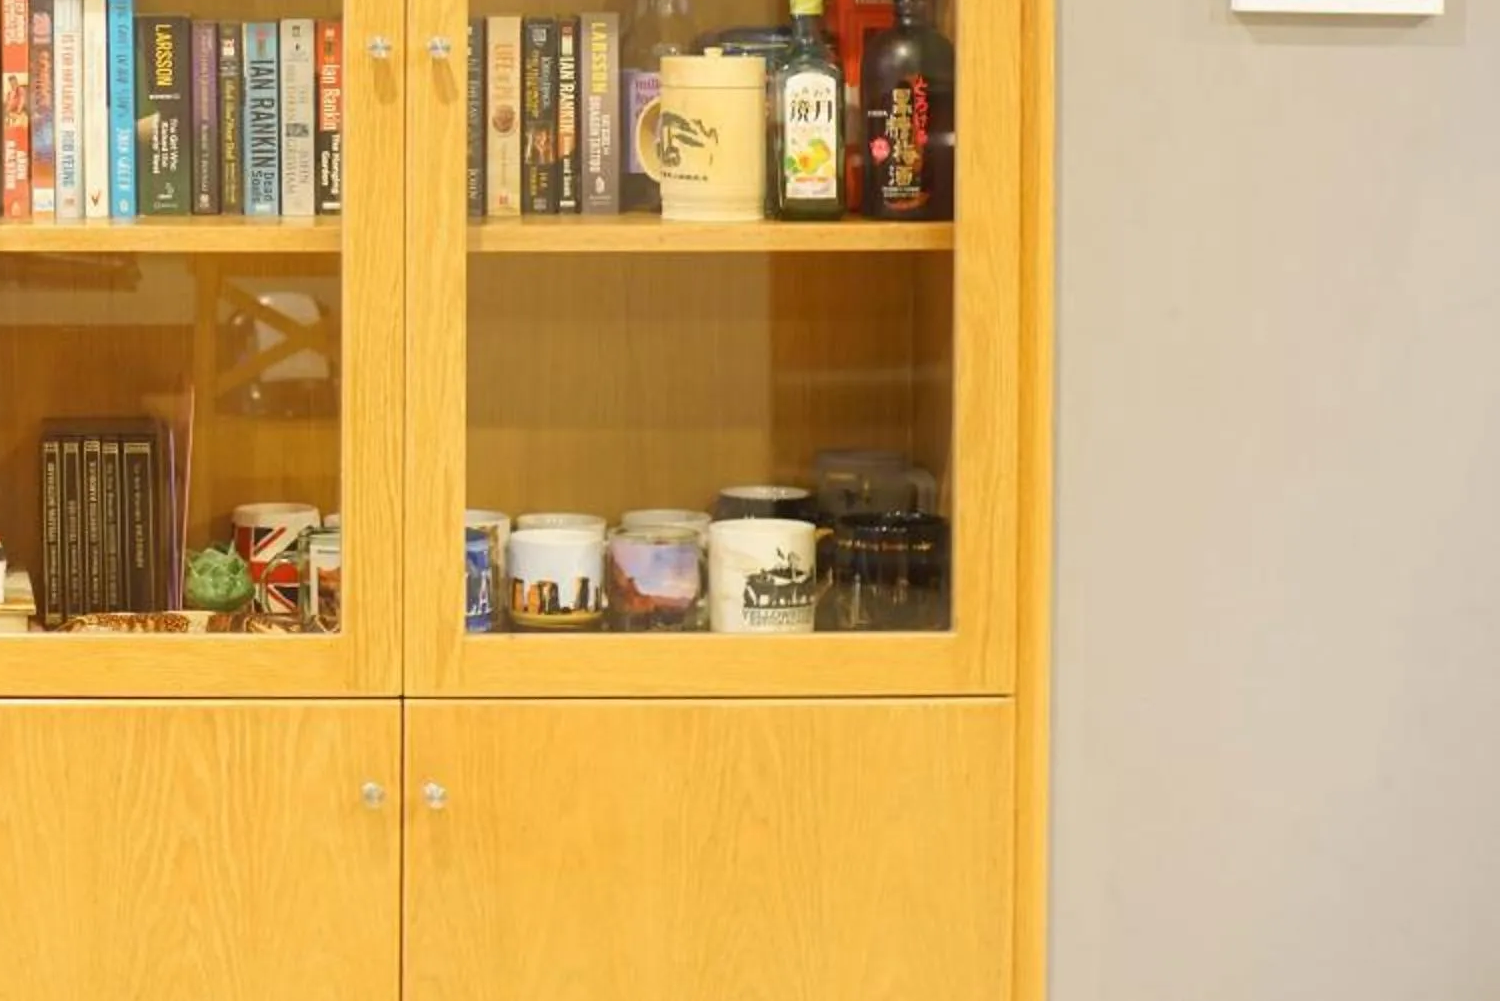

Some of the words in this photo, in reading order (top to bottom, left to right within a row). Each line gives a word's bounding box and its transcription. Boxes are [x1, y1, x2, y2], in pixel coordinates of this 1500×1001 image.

[155, 24, 173, 86] LARSSON
[251, 60, 276, 90] IAN
[320, 64, 341, 84] Ian
[560, 56, 575, 79] IAN
[591, 21, 609, 93] LARSSON
[321, 88, 342, 131] Rankin
[560, 83, 575, 134] RANKIN
[251, 97, 277, 168] RANKIN
[264, 171, 275, 202] Dead
[321, 150, 330, 186] Garden
[329, 153, 341, 195] Hanging
